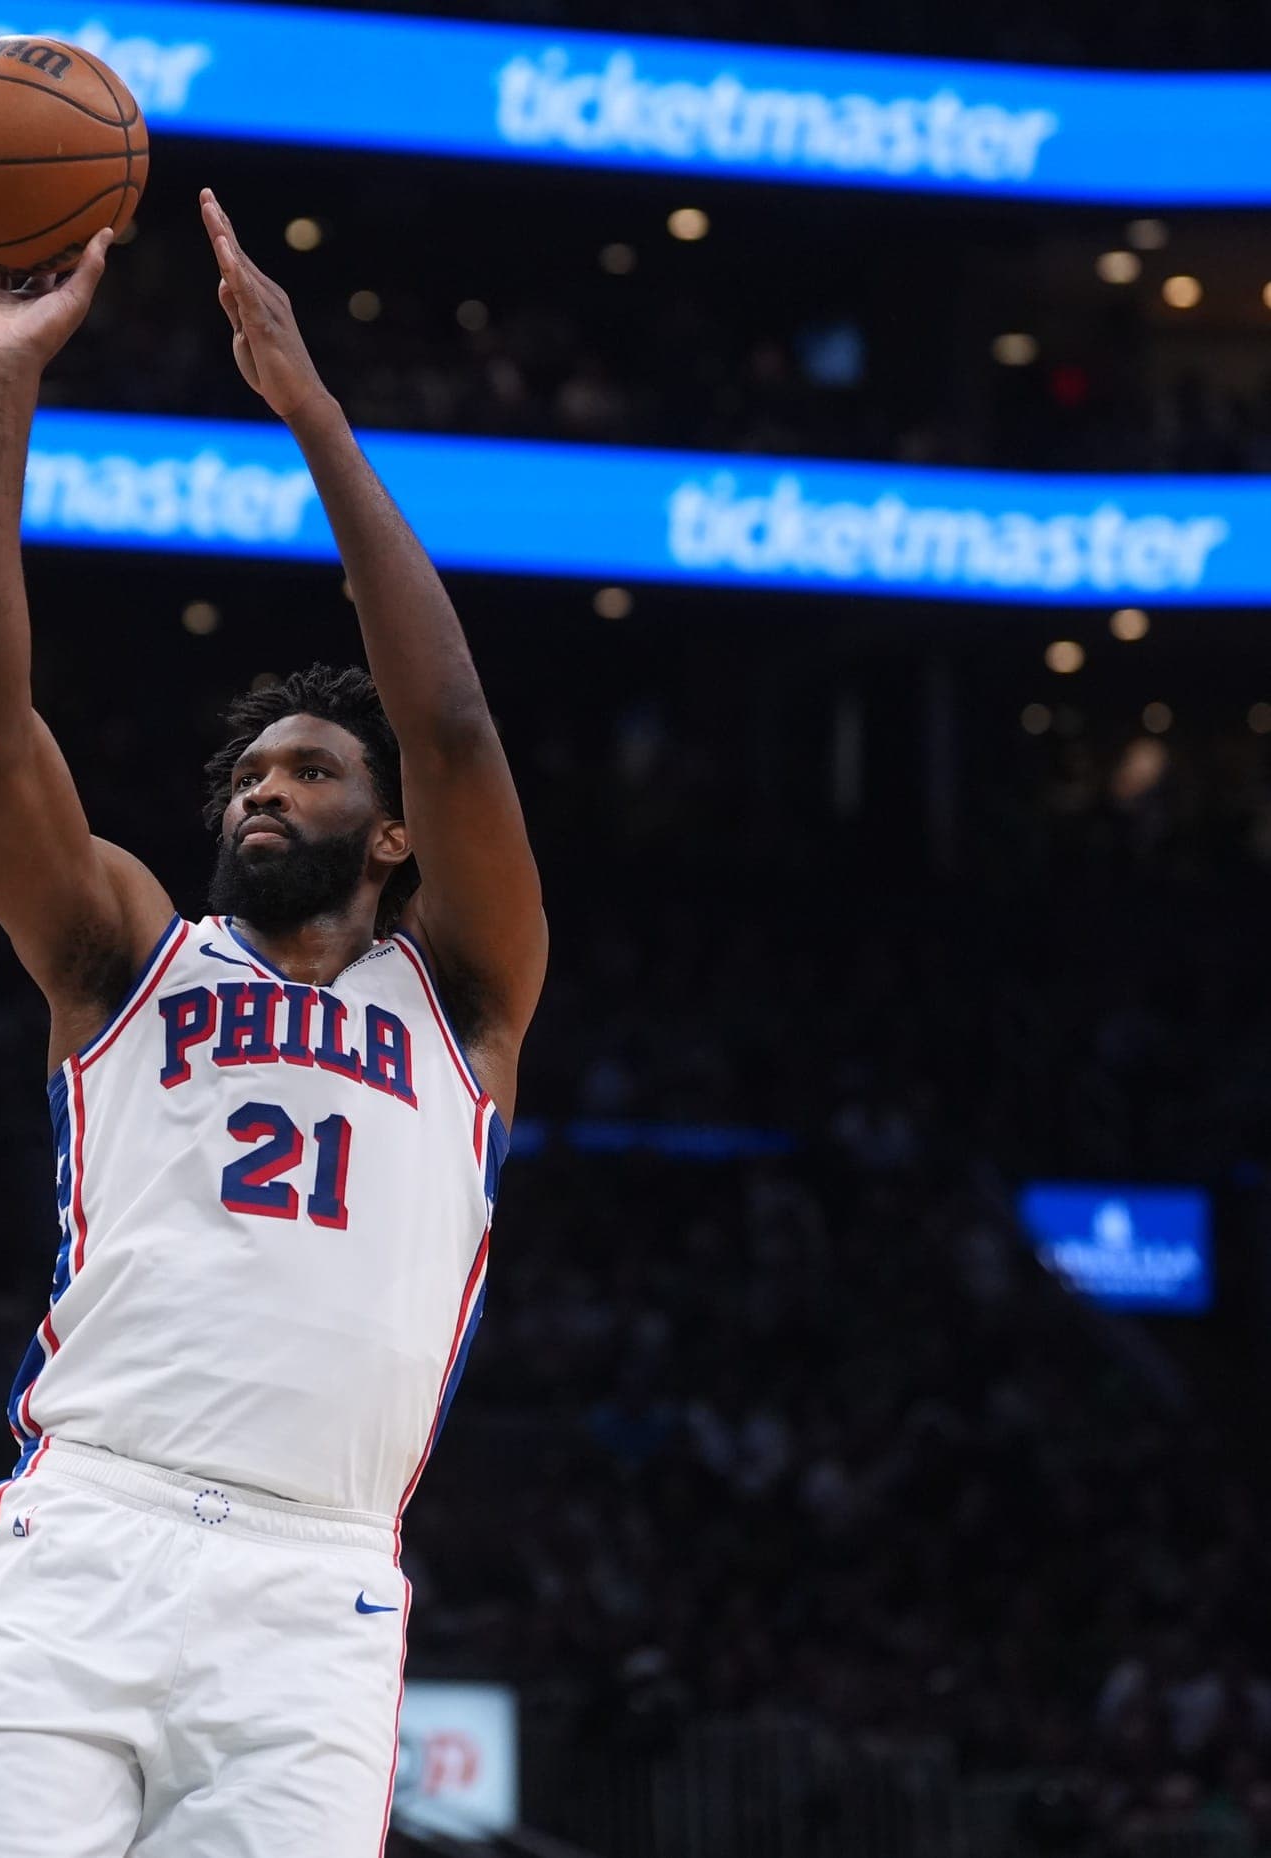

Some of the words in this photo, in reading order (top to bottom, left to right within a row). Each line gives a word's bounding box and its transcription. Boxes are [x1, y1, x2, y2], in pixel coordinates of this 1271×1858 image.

[498, 50, 1054, 178] ticketmaster
[669, 478, 1226, 589] ticketmaster
[157, 981, 418, 1111] PHILA
[220, 1101, 352, 1230] 21
